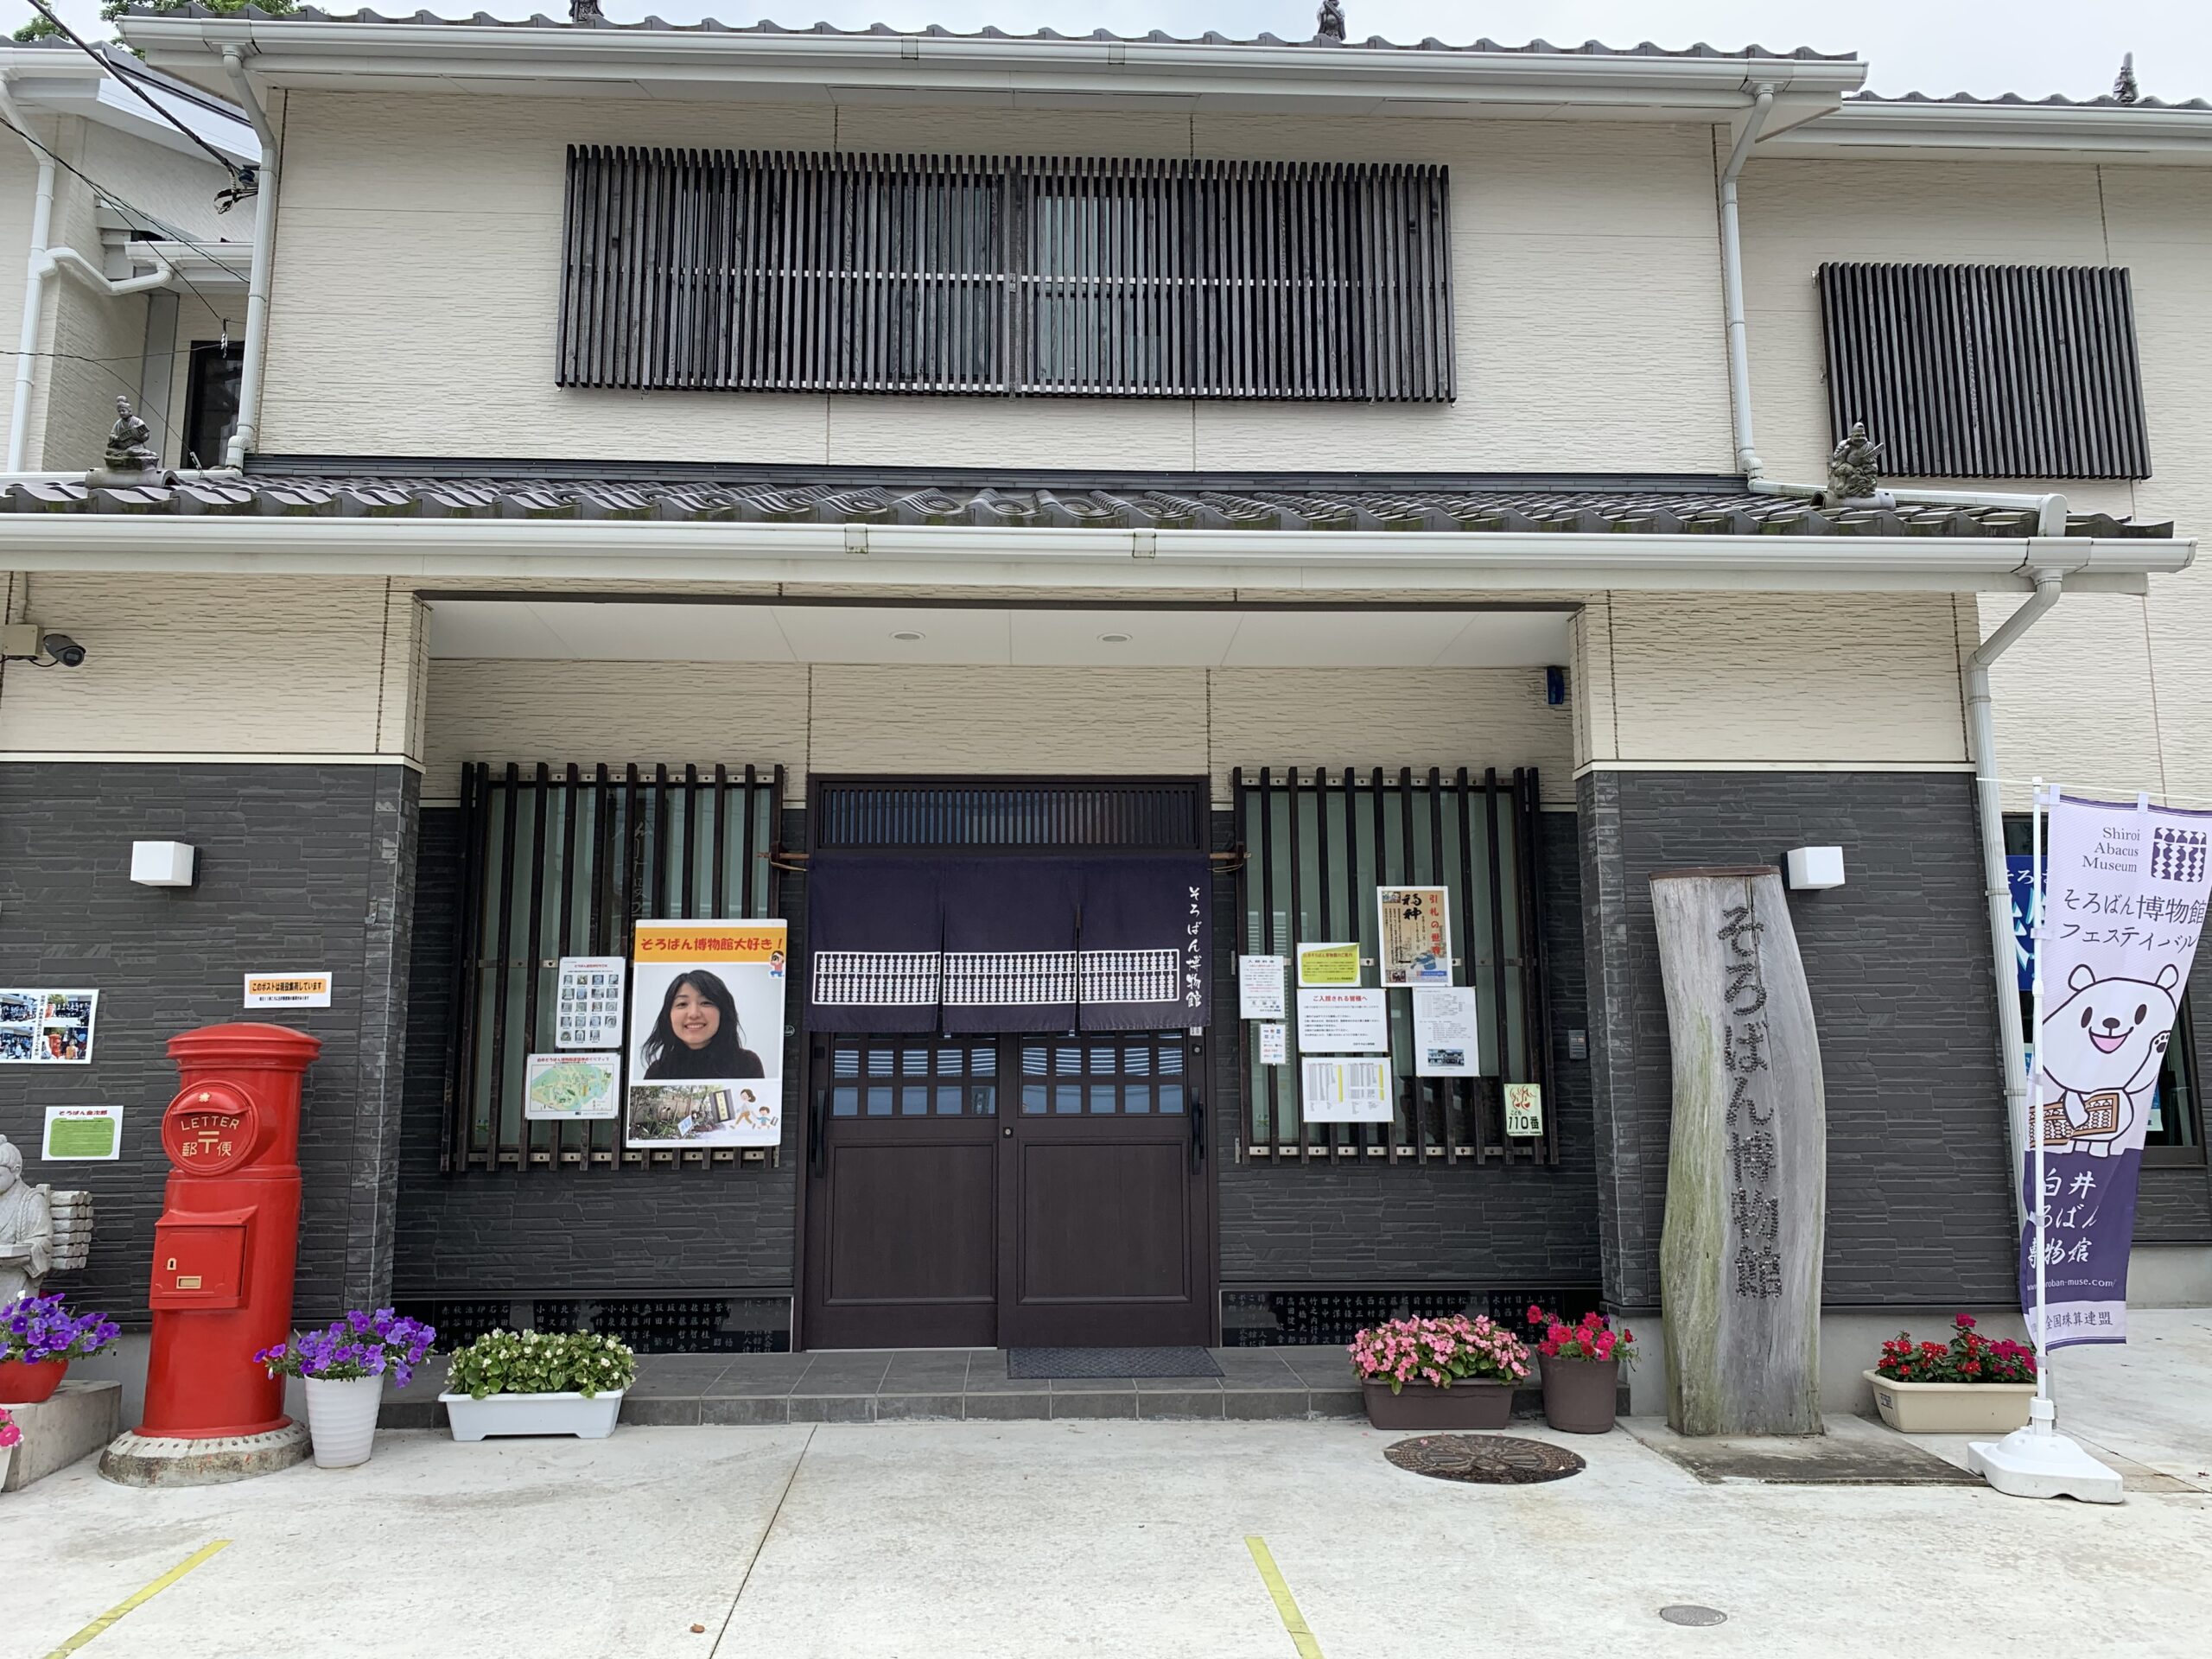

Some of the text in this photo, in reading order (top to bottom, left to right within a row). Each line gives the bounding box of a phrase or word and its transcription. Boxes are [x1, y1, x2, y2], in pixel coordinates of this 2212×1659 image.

[2102, 827, 2140, 841] Shiroi
[2094, 842, 2139, 856] Abacus
[2082, 855, 2137, 873] Museum
[2064, 888, 2208, 925] そろばん博物館
[1185, 886, 1202, 1008] そろばん博物館
[2059, 922, 2199, 954] フェスティバル
[1717, 906, 1783, 1299] そろばん博物館
[181, 1116, 240, 1131] LETTER
[1509, 1116, 1540, 1130] 110番
